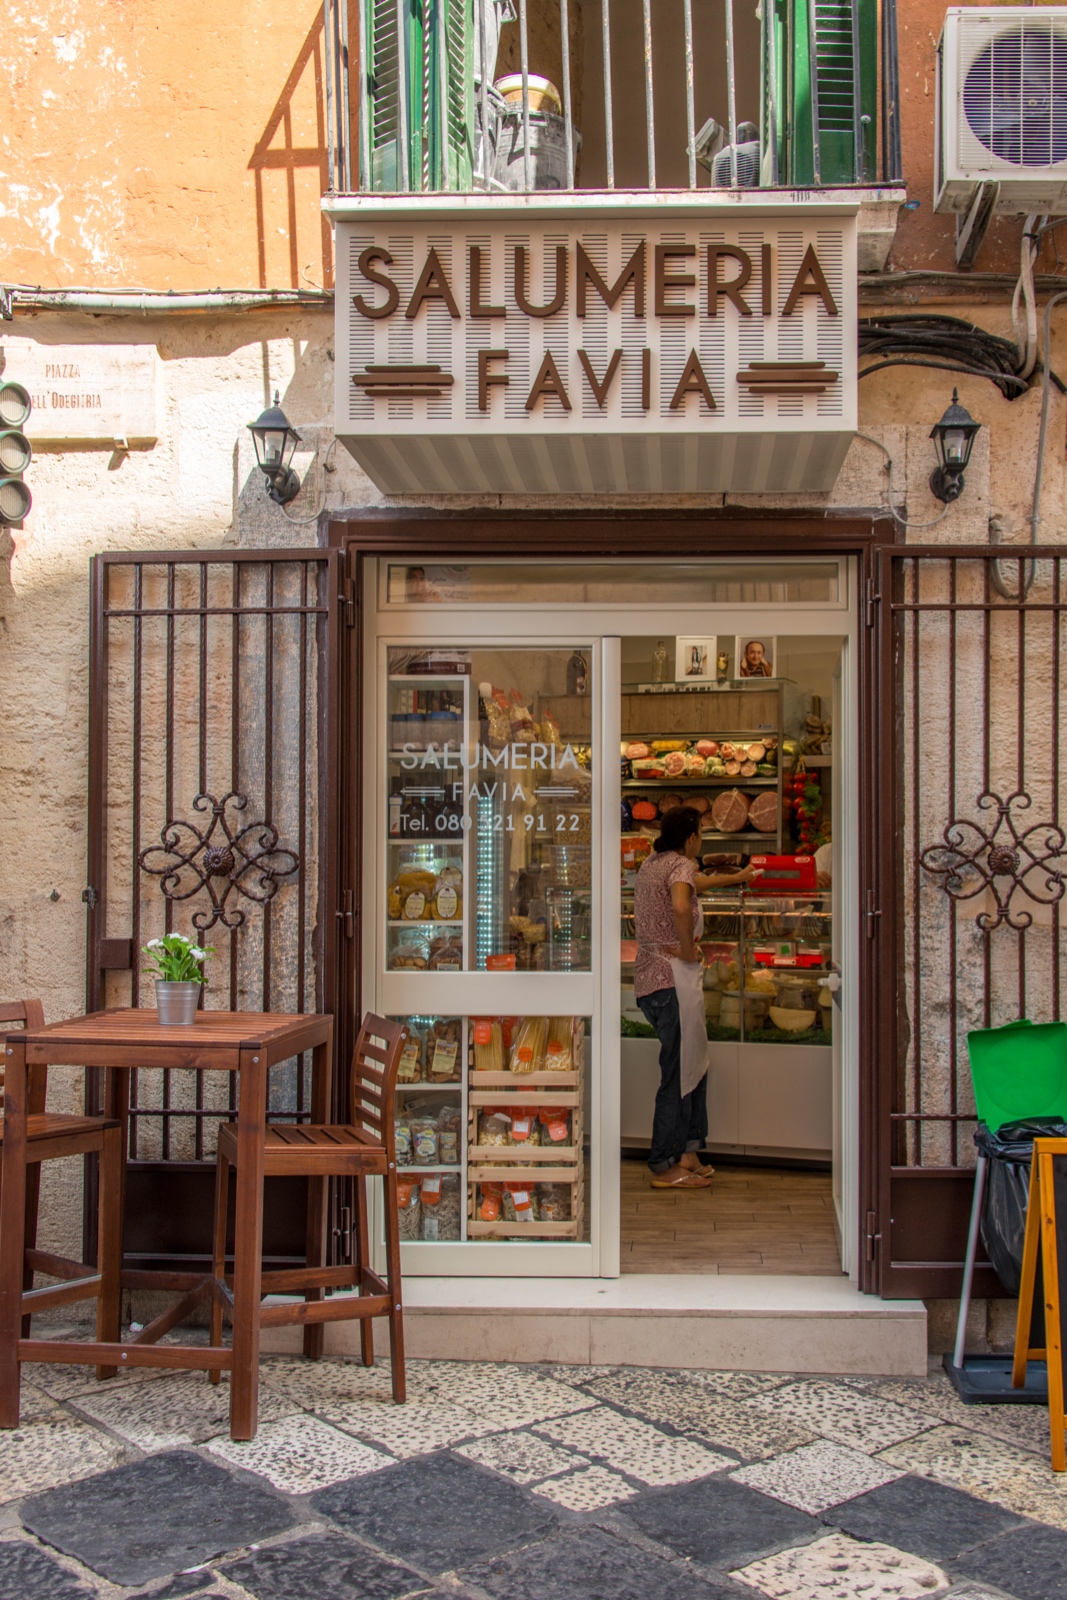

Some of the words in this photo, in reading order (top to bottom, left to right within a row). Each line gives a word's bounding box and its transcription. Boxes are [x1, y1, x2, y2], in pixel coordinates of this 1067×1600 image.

[352, 239, 839, 319] SALUMERIA
[45, 364, 81, 378] PIAZZA
[478, 348, 717, 411] FAVIA
[400, 742, 579, 770] SALUMERIA
[452, 782, 526, 801] FAVIA
[400, 814, 429, 831] Tel.
[435, 814, 472, 831] 080
[478, 814, 515, 831] 521
[524, 814, 546, 831] 91
[556, 814, 579, 831] 22
